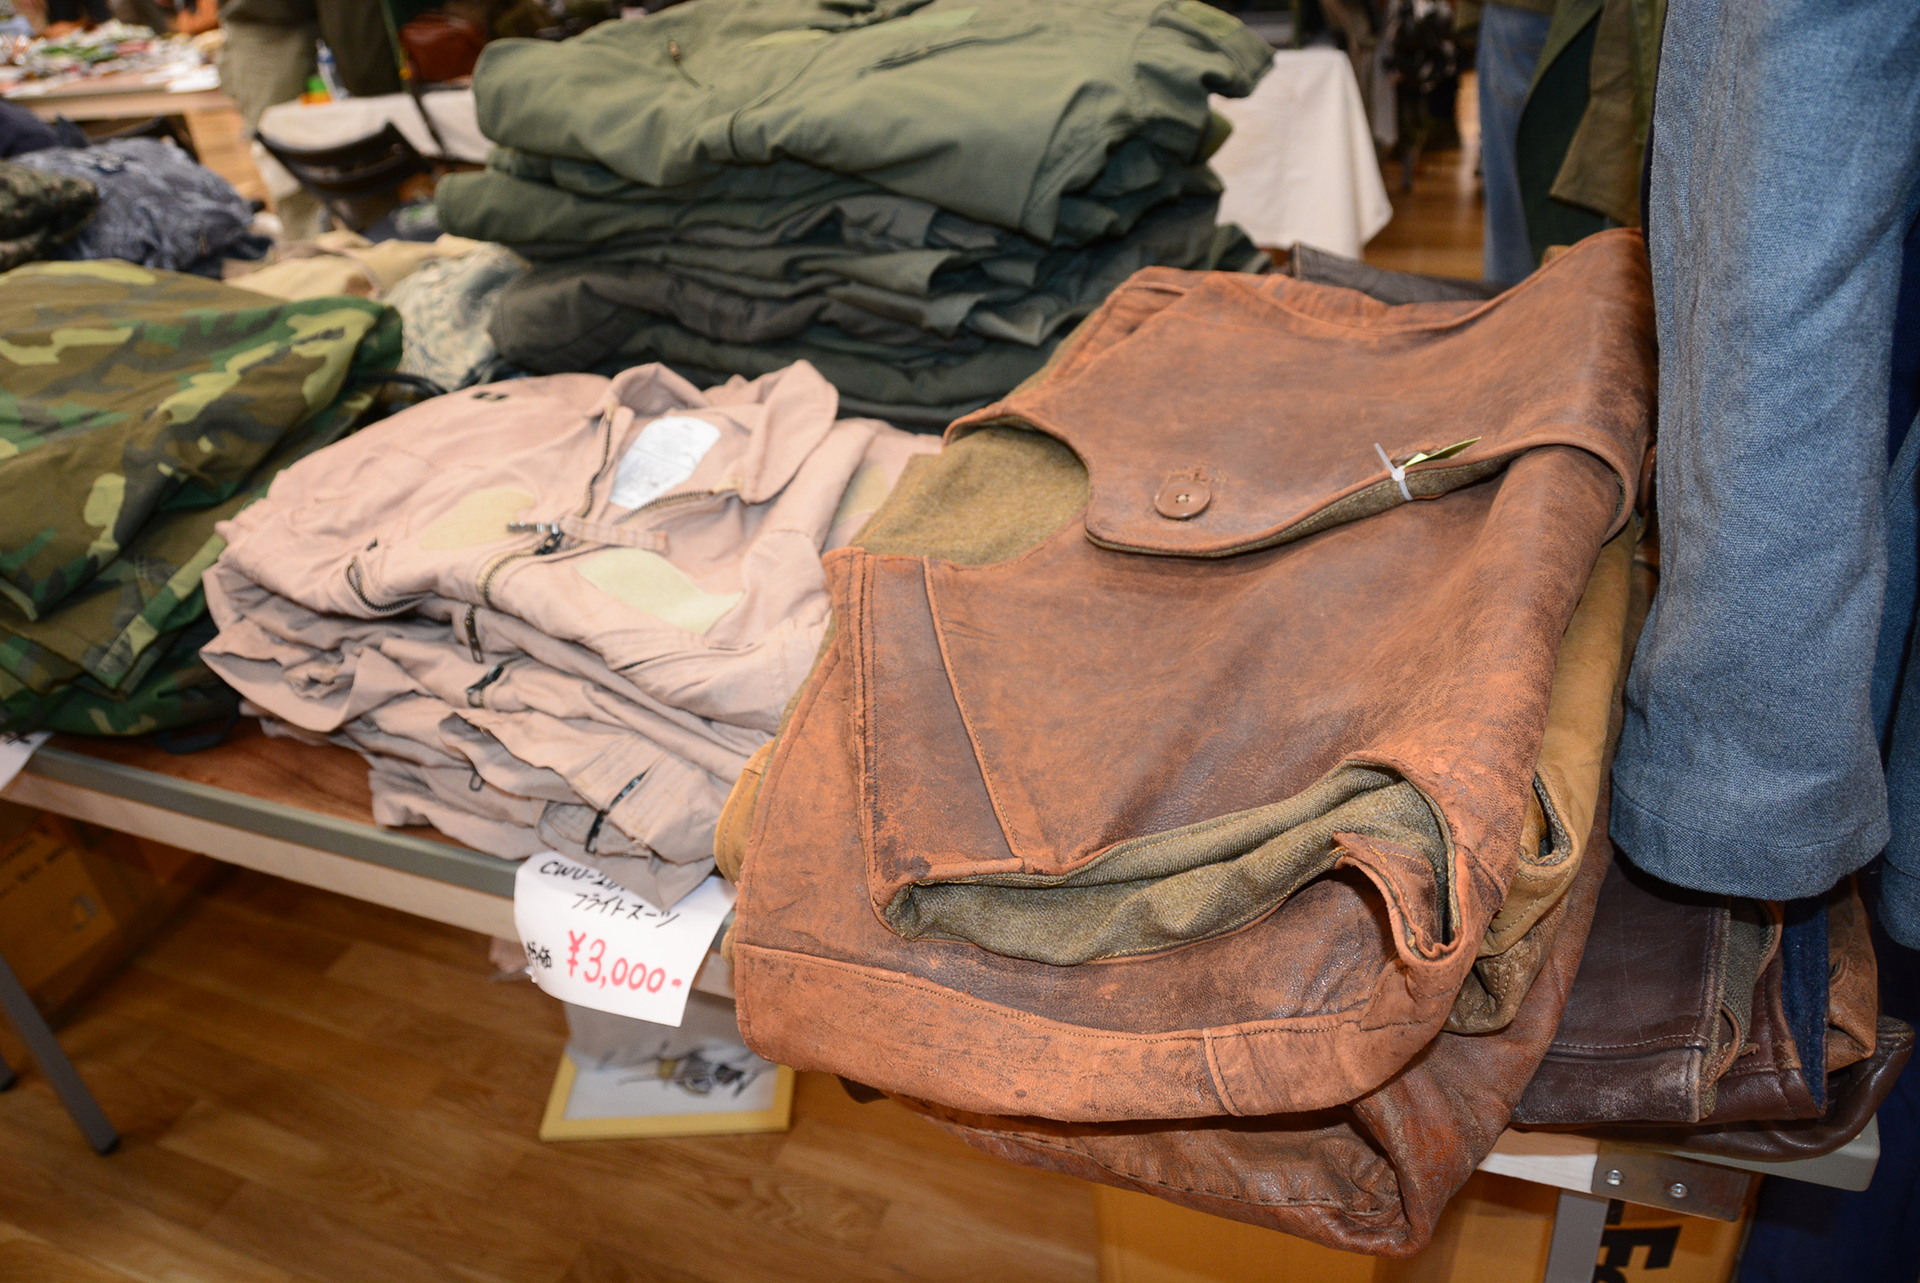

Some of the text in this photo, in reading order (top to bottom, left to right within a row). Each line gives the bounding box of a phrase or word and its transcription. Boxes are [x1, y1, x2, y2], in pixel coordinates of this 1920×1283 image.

[571, 893, 680, 928] フライトスーツ
